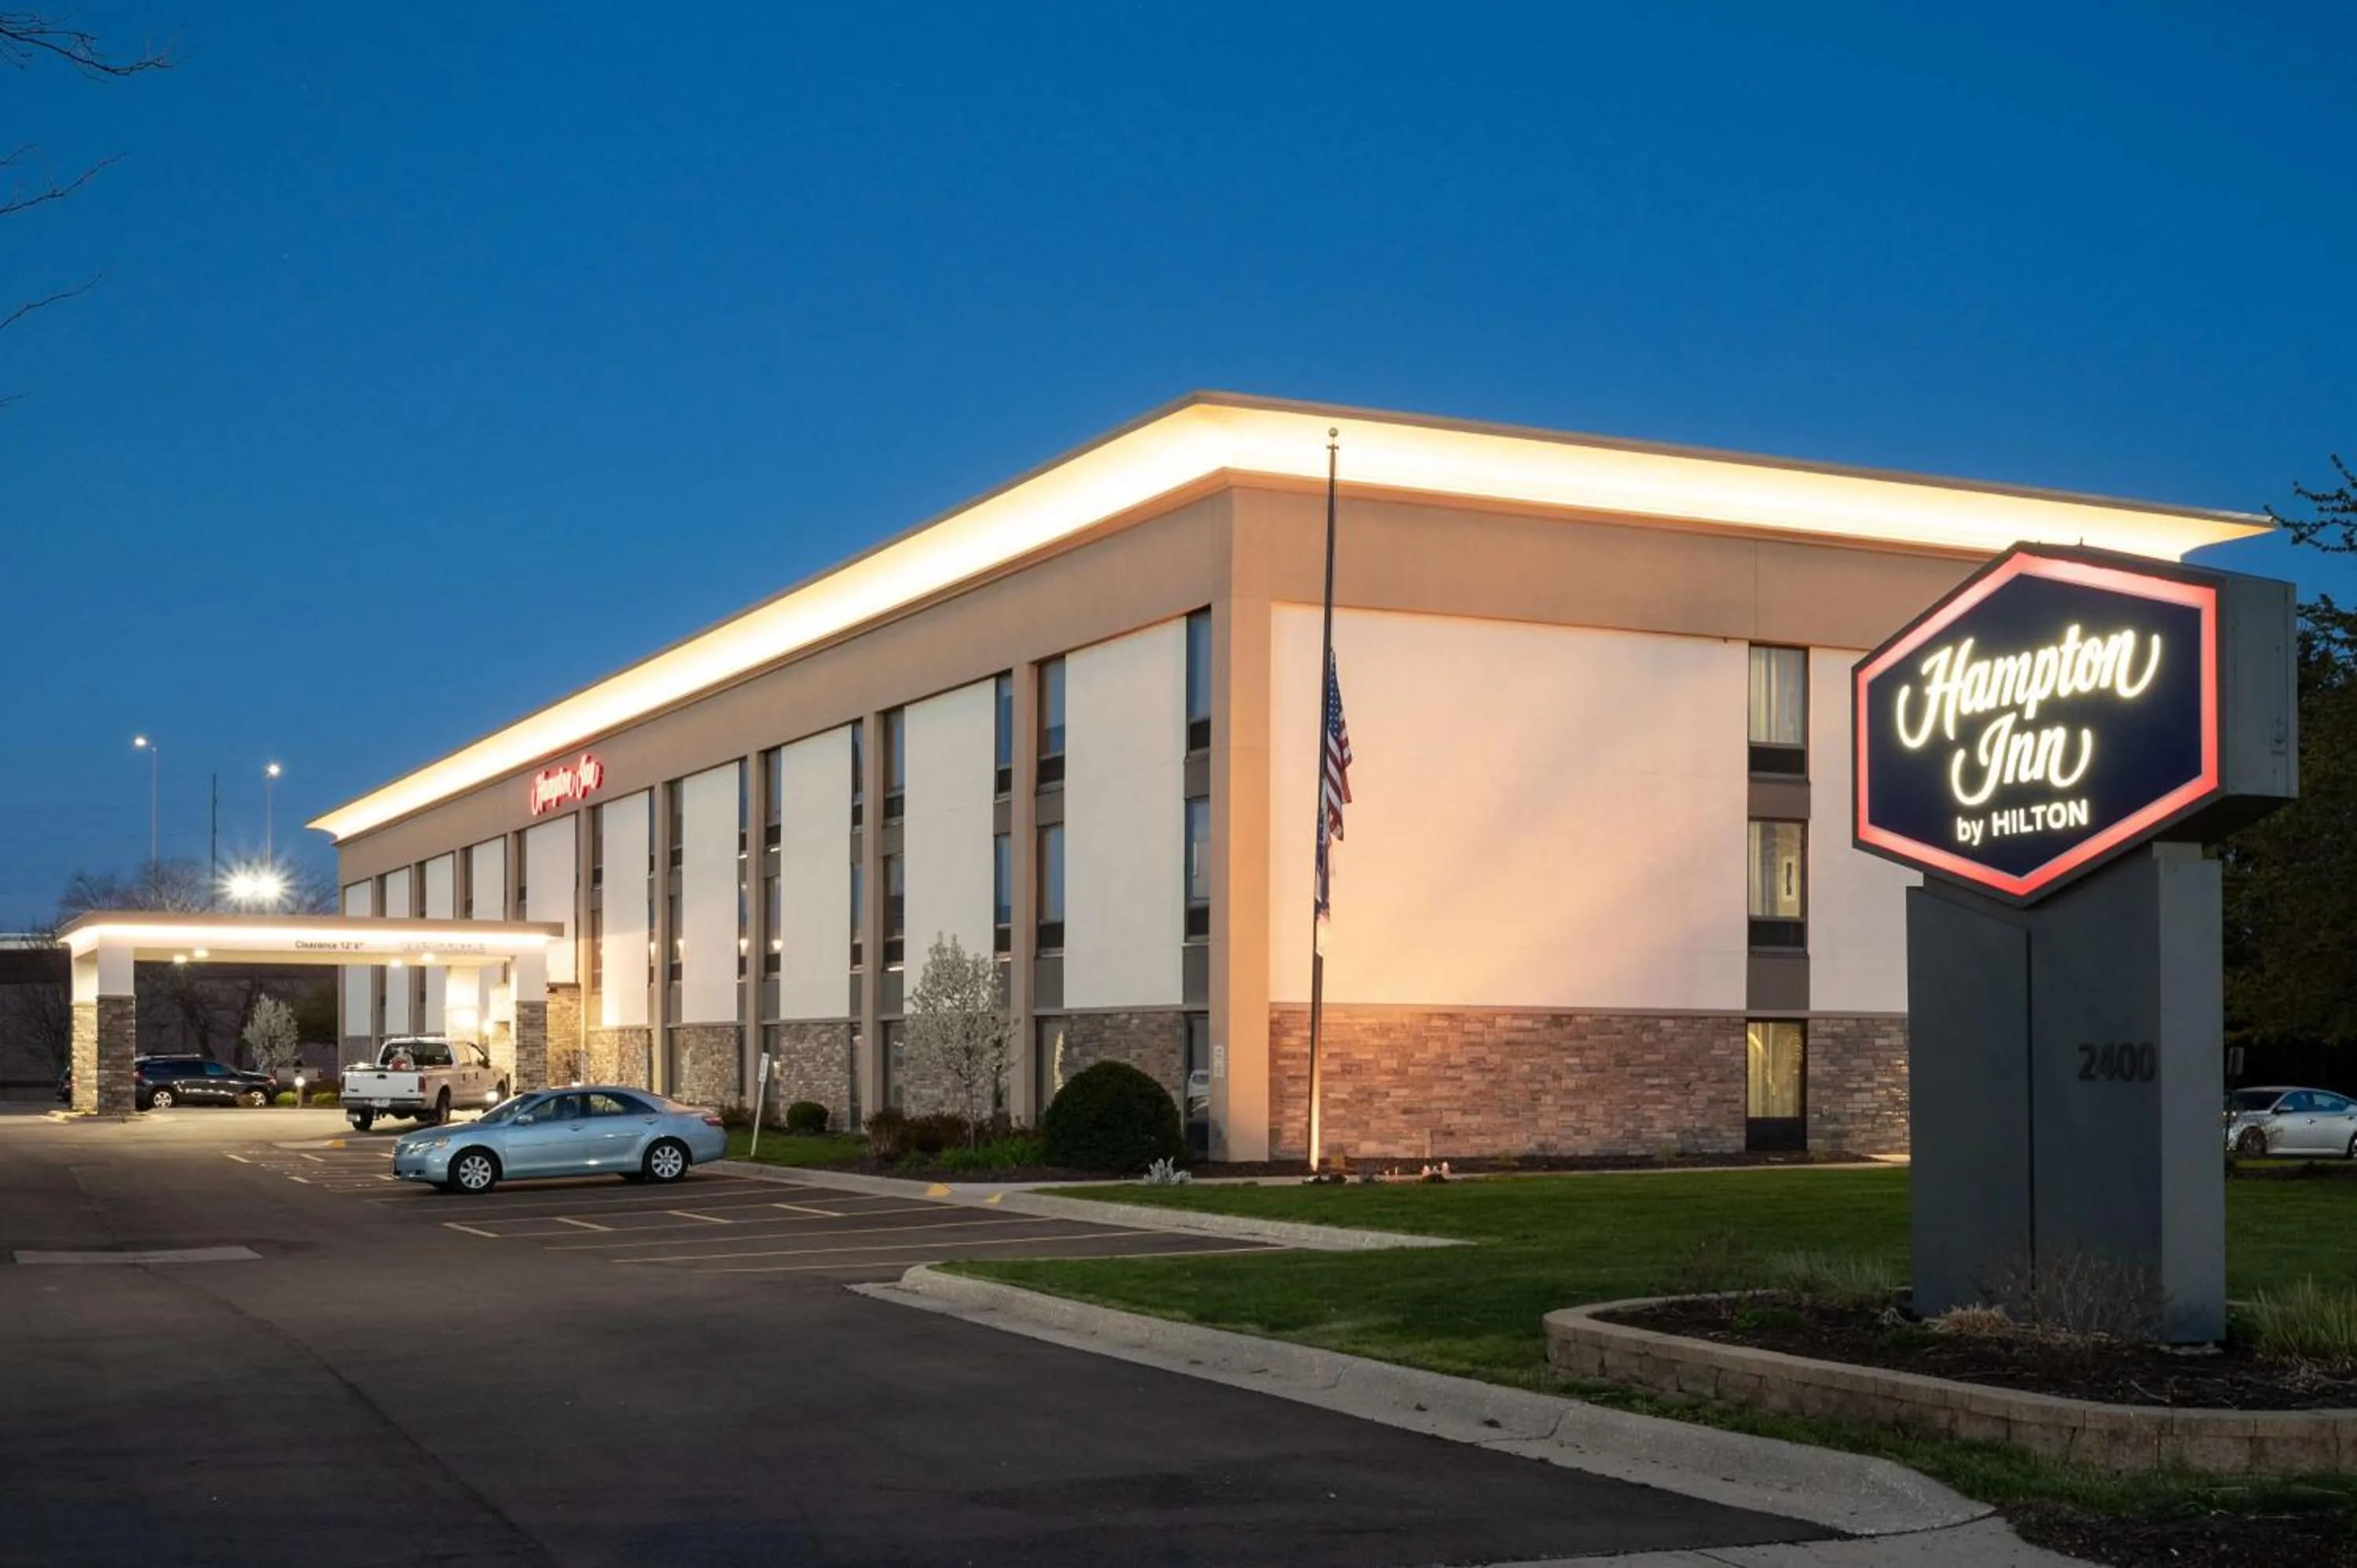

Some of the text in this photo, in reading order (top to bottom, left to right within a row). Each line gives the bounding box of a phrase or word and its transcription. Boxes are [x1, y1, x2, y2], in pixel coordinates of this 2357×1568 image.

[1896, 622, 2161, 749] Hampton
[1951, 712, 2093, 806] Inn
[1956, 799, 2090, 846] by HILTON
[295, 940, 338, 950] Clearance
[2077, 1042, 2157, 1083] 2400
